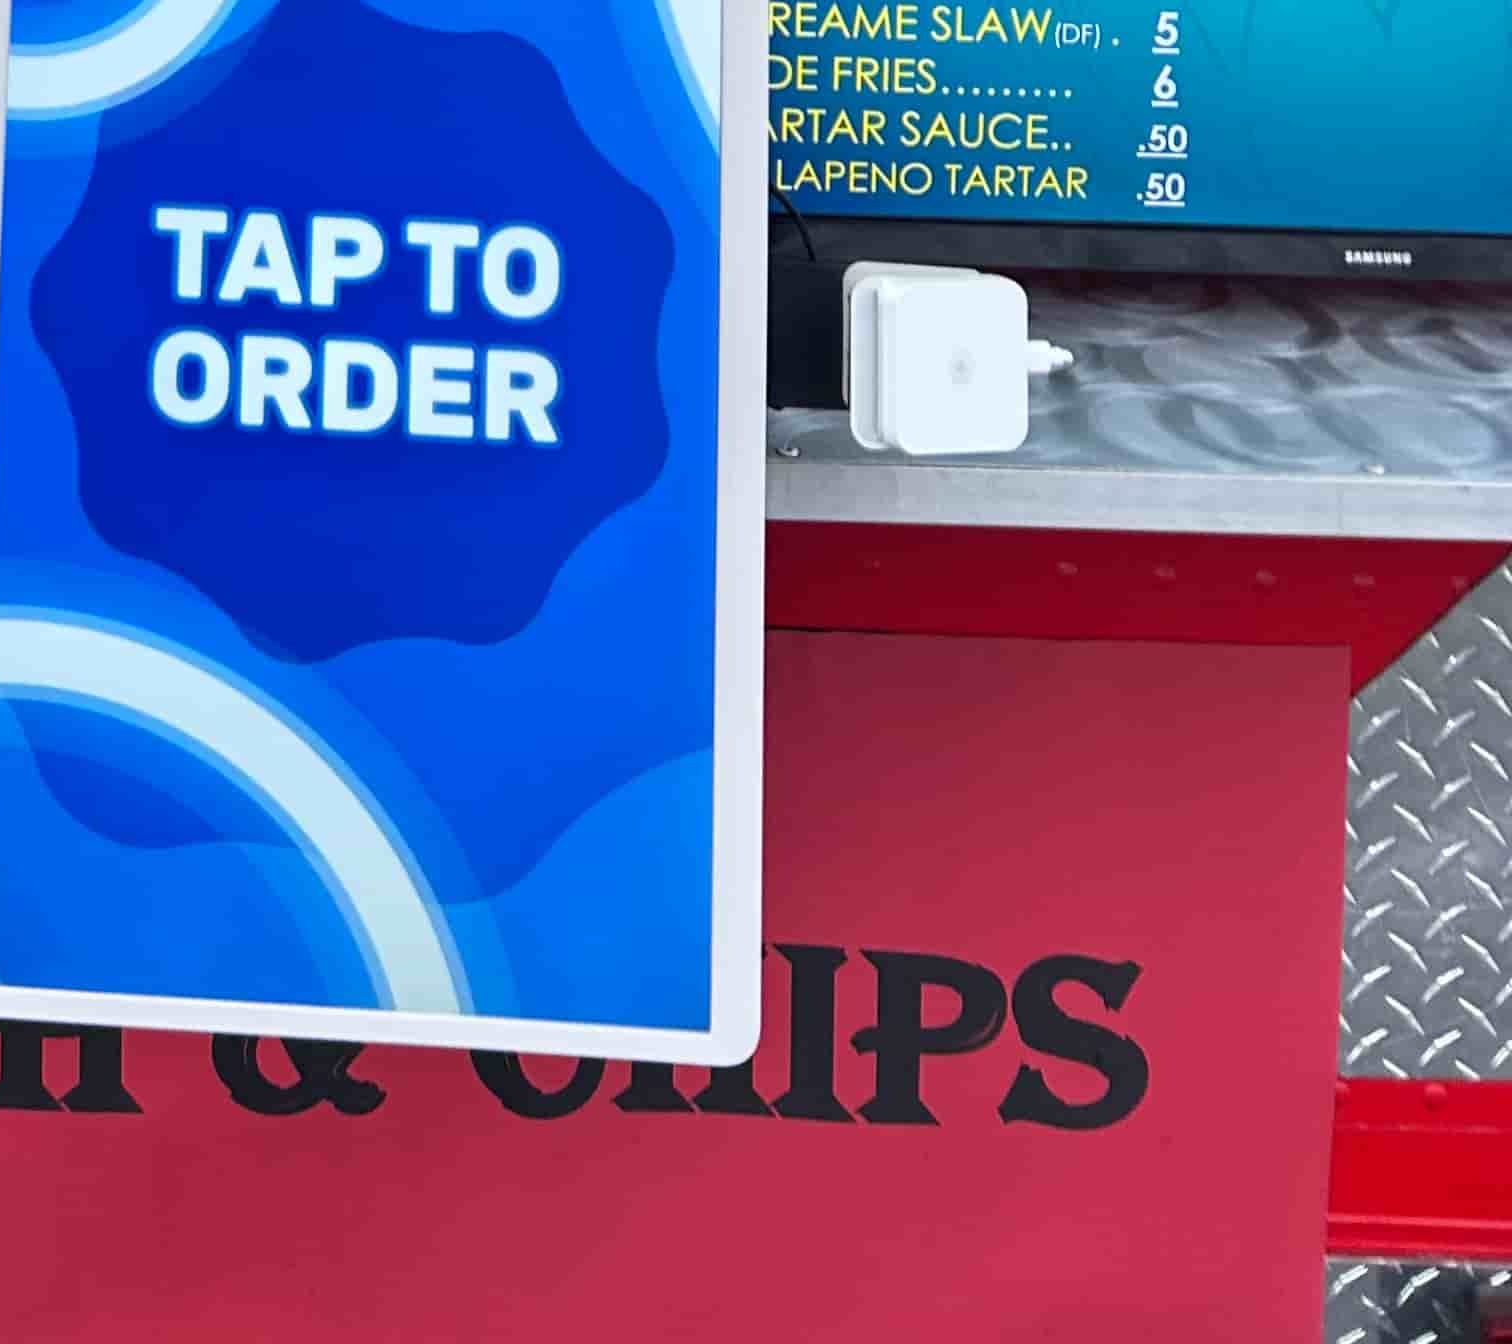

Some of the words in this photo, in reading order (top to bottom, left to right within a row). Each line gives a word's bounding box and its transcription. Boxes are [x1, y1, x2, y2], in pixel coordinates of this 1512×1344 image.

[769, 2, 919, 41] REAME
[1153, 11, 1180, 47] 5
[769, 54, 819, 92] DE
[1152, 64, 1177, 100] 6
[769, 107, 885, 145] RTAR
[1138, 124, 1188, 153] .50
[775, 159, 934, 195] LAPENO
[944, 163, 1088, 199] TARTAR
[1136, 173, 1186, 201] .50
[156, 207, 384, 306] TAP
[406, 220, 560, 318] TO
[152, 330, 559, 443] ORDER
